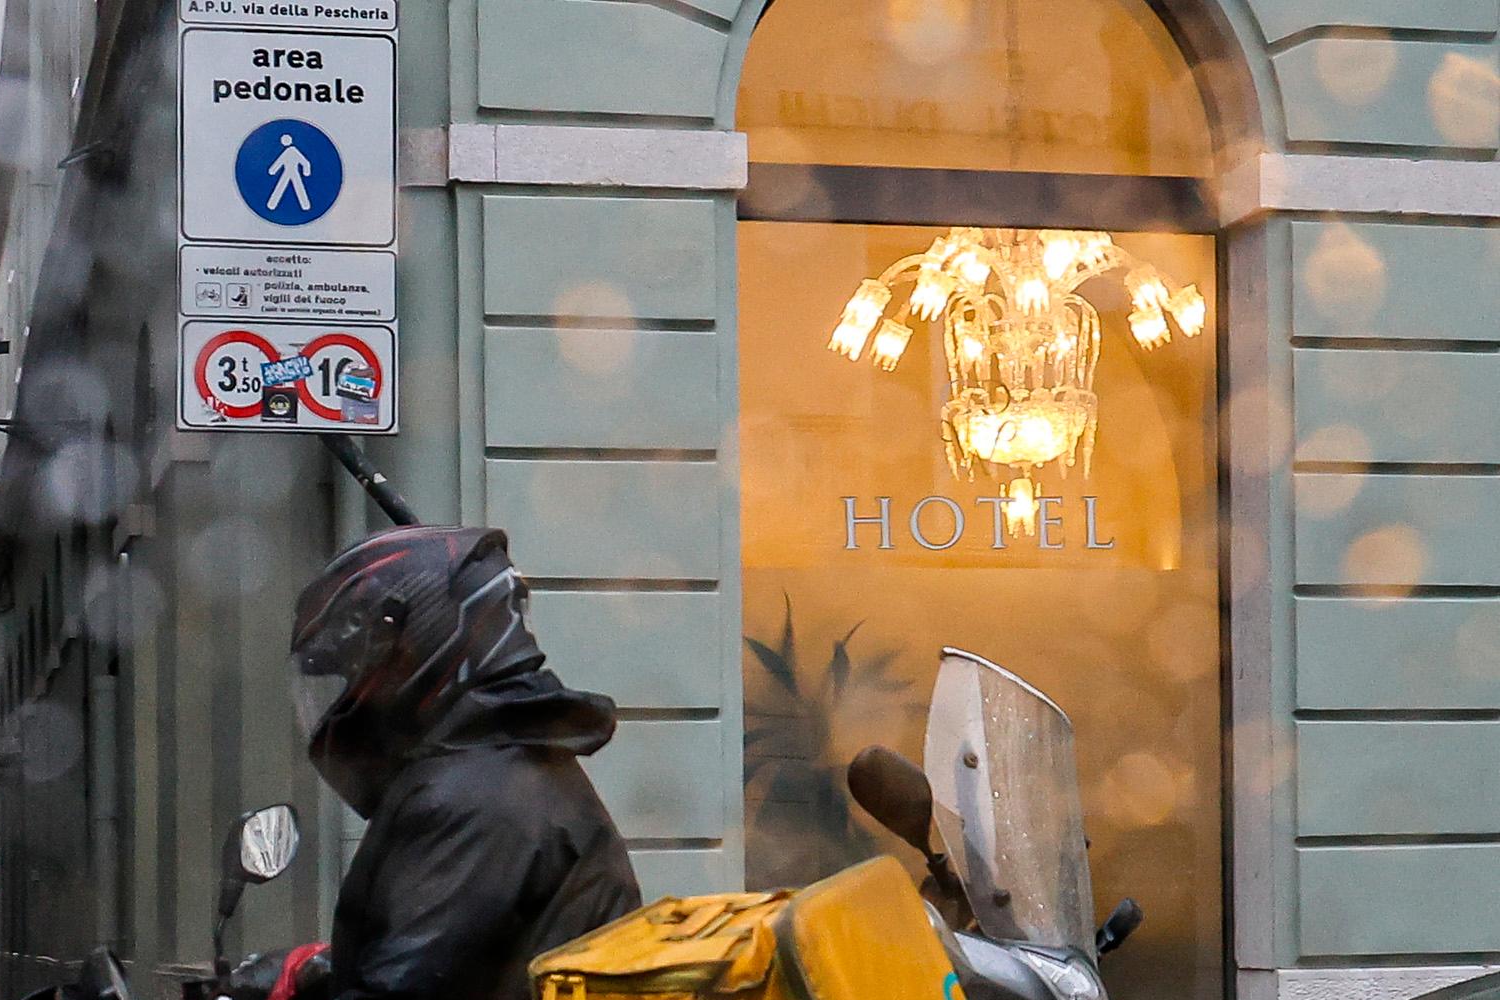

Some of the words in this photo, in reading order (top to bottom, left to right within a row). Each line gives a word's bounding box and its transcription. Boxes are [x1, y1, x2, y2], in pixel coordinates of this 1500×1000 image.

[188, 0, 237, 14] A.P.U.
[242, 3, 265, 15] via
[270, 4, 309, 17] della
[314, 5, 389, 20] Pescheria
[252, 48, 323, 69] area
[213, 76, 364, 104] pedonale
[266, 254, 312, 264] eccetto:
[243, 268, 302, 278] autorizzati
[263, 294, 291, 304] vigili
[315, 295, 346, 305] fuoco
[840, 496, 1115, 550] HOTEL
